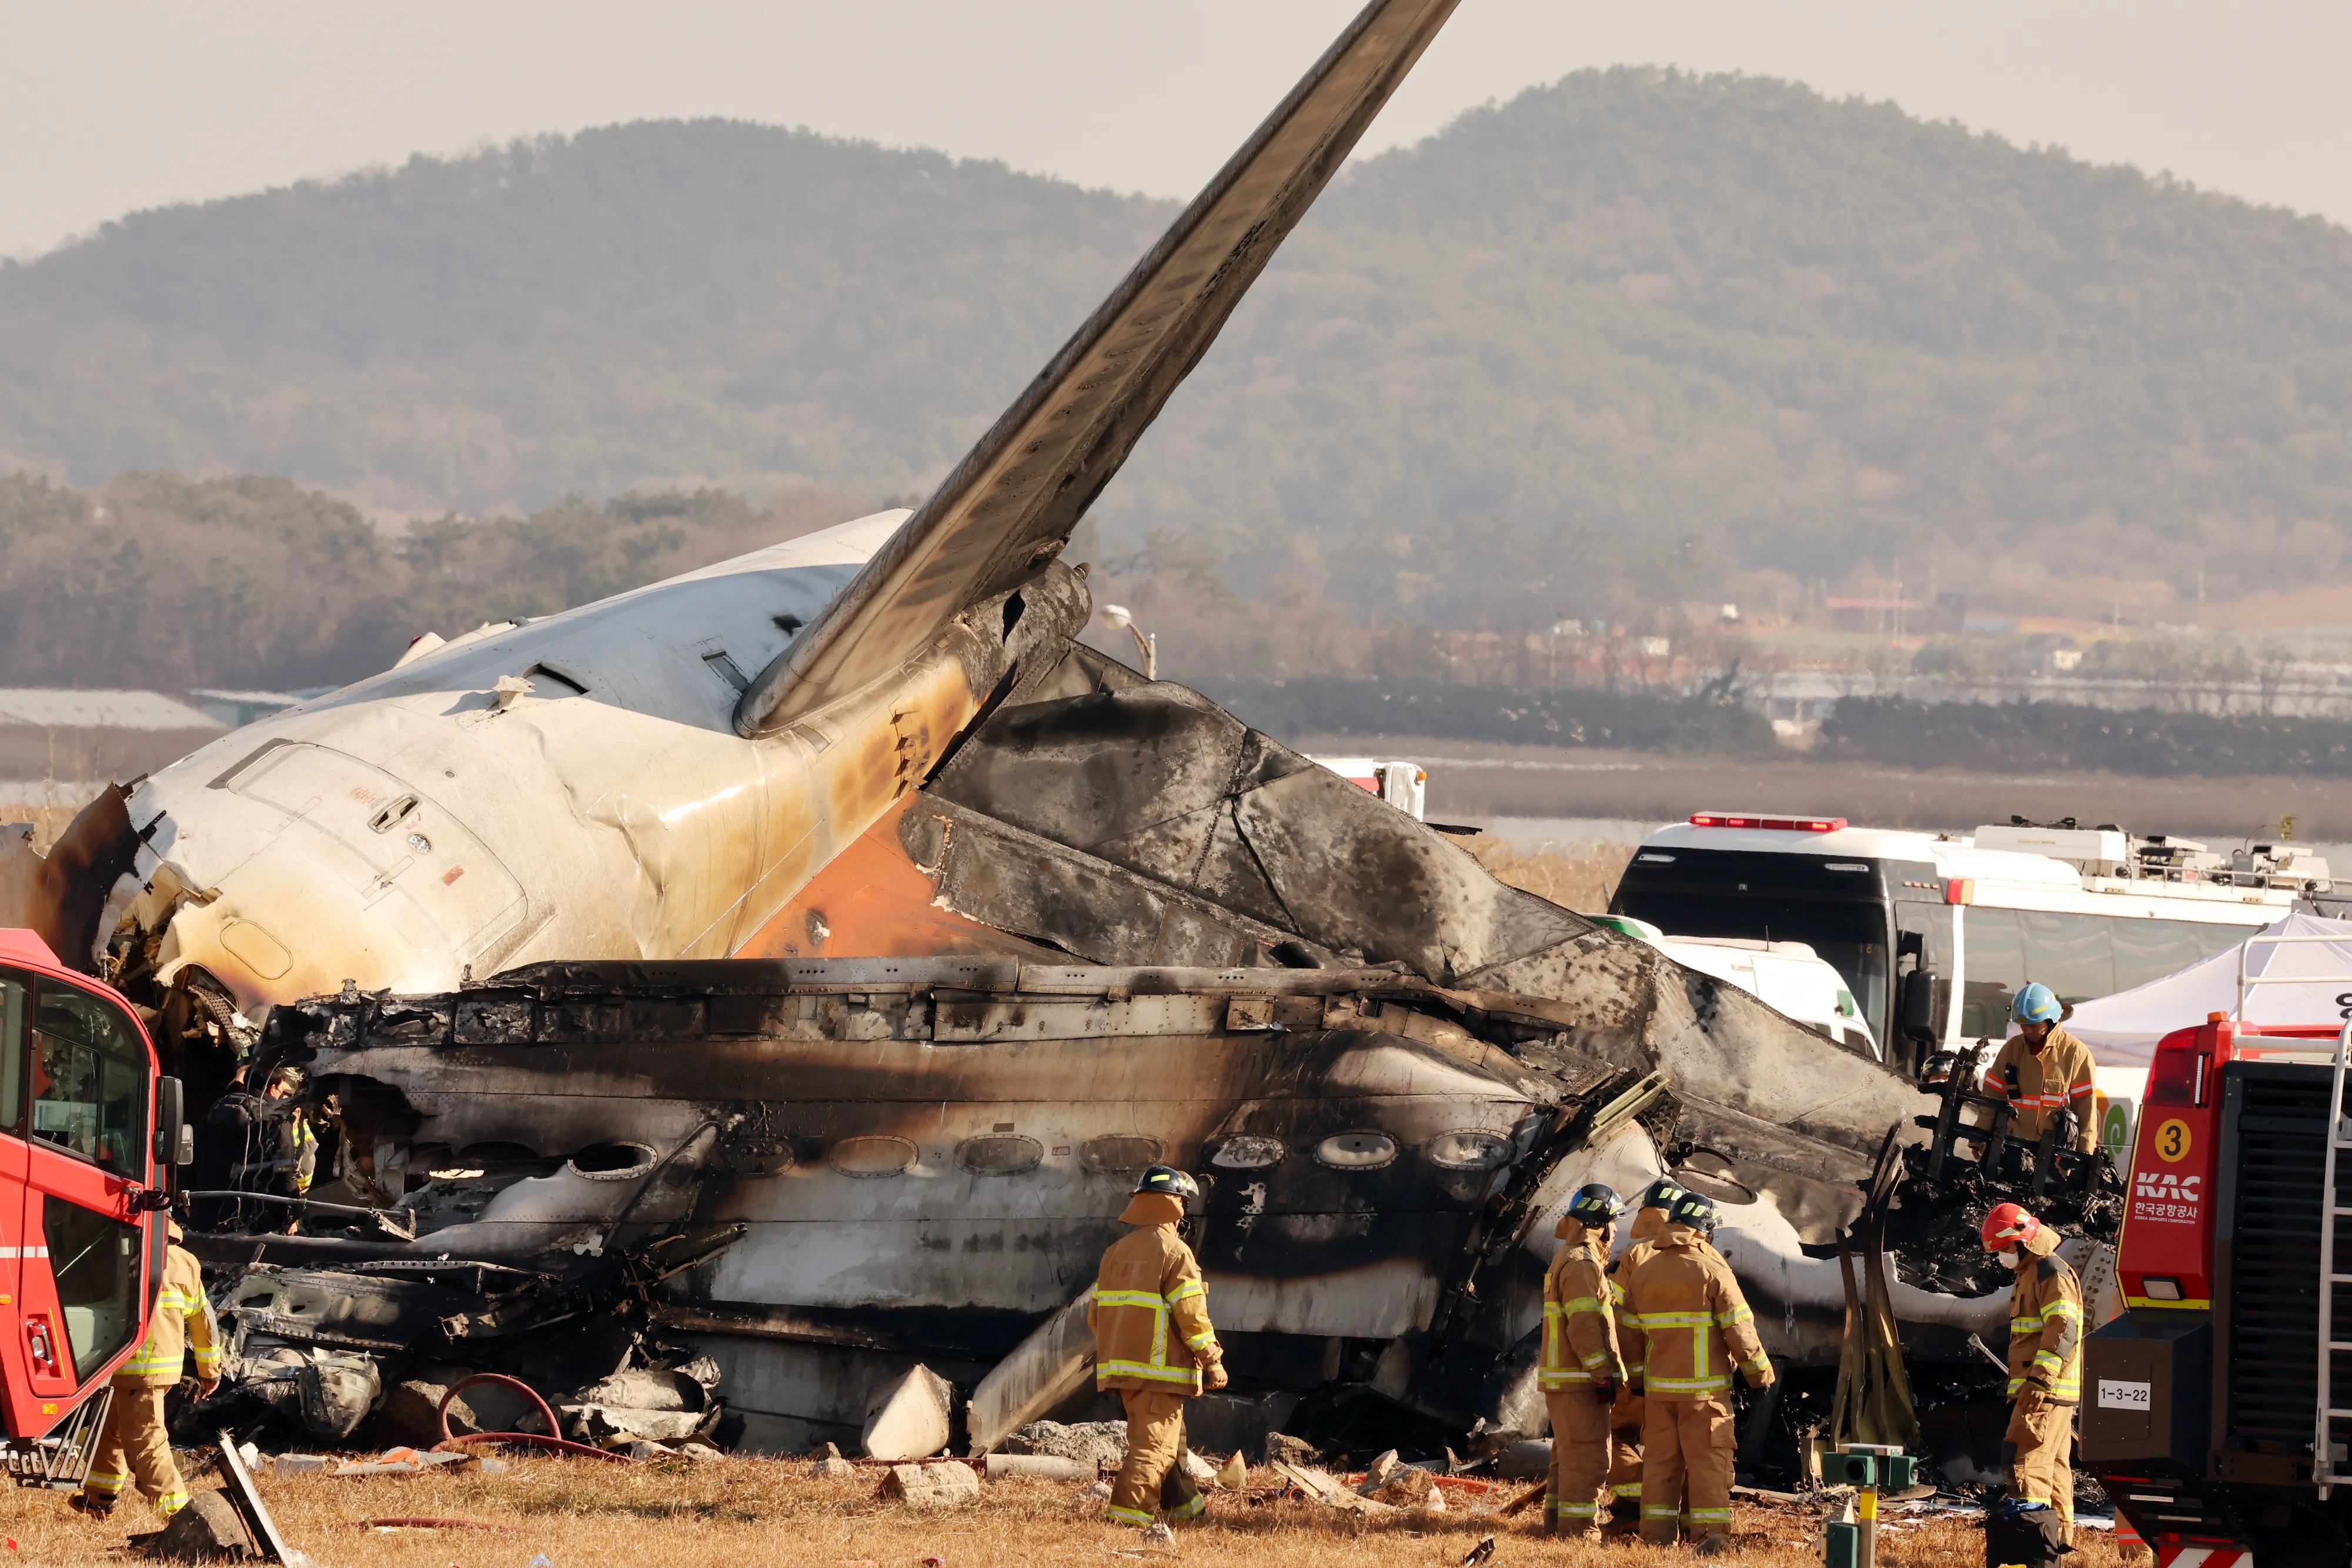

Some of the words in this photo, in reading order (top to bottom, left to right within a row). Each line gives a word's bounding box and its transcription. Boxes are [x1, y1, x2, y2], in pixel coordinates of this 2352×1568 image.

[2164, 1125, 2181, 1156] 3
[2136, 1172, 2200, 1201] KAC
[2135, 1202, 2198, 1218] 한국공항공사
[2102, 1388, 2147, 1402] 1-3-22
